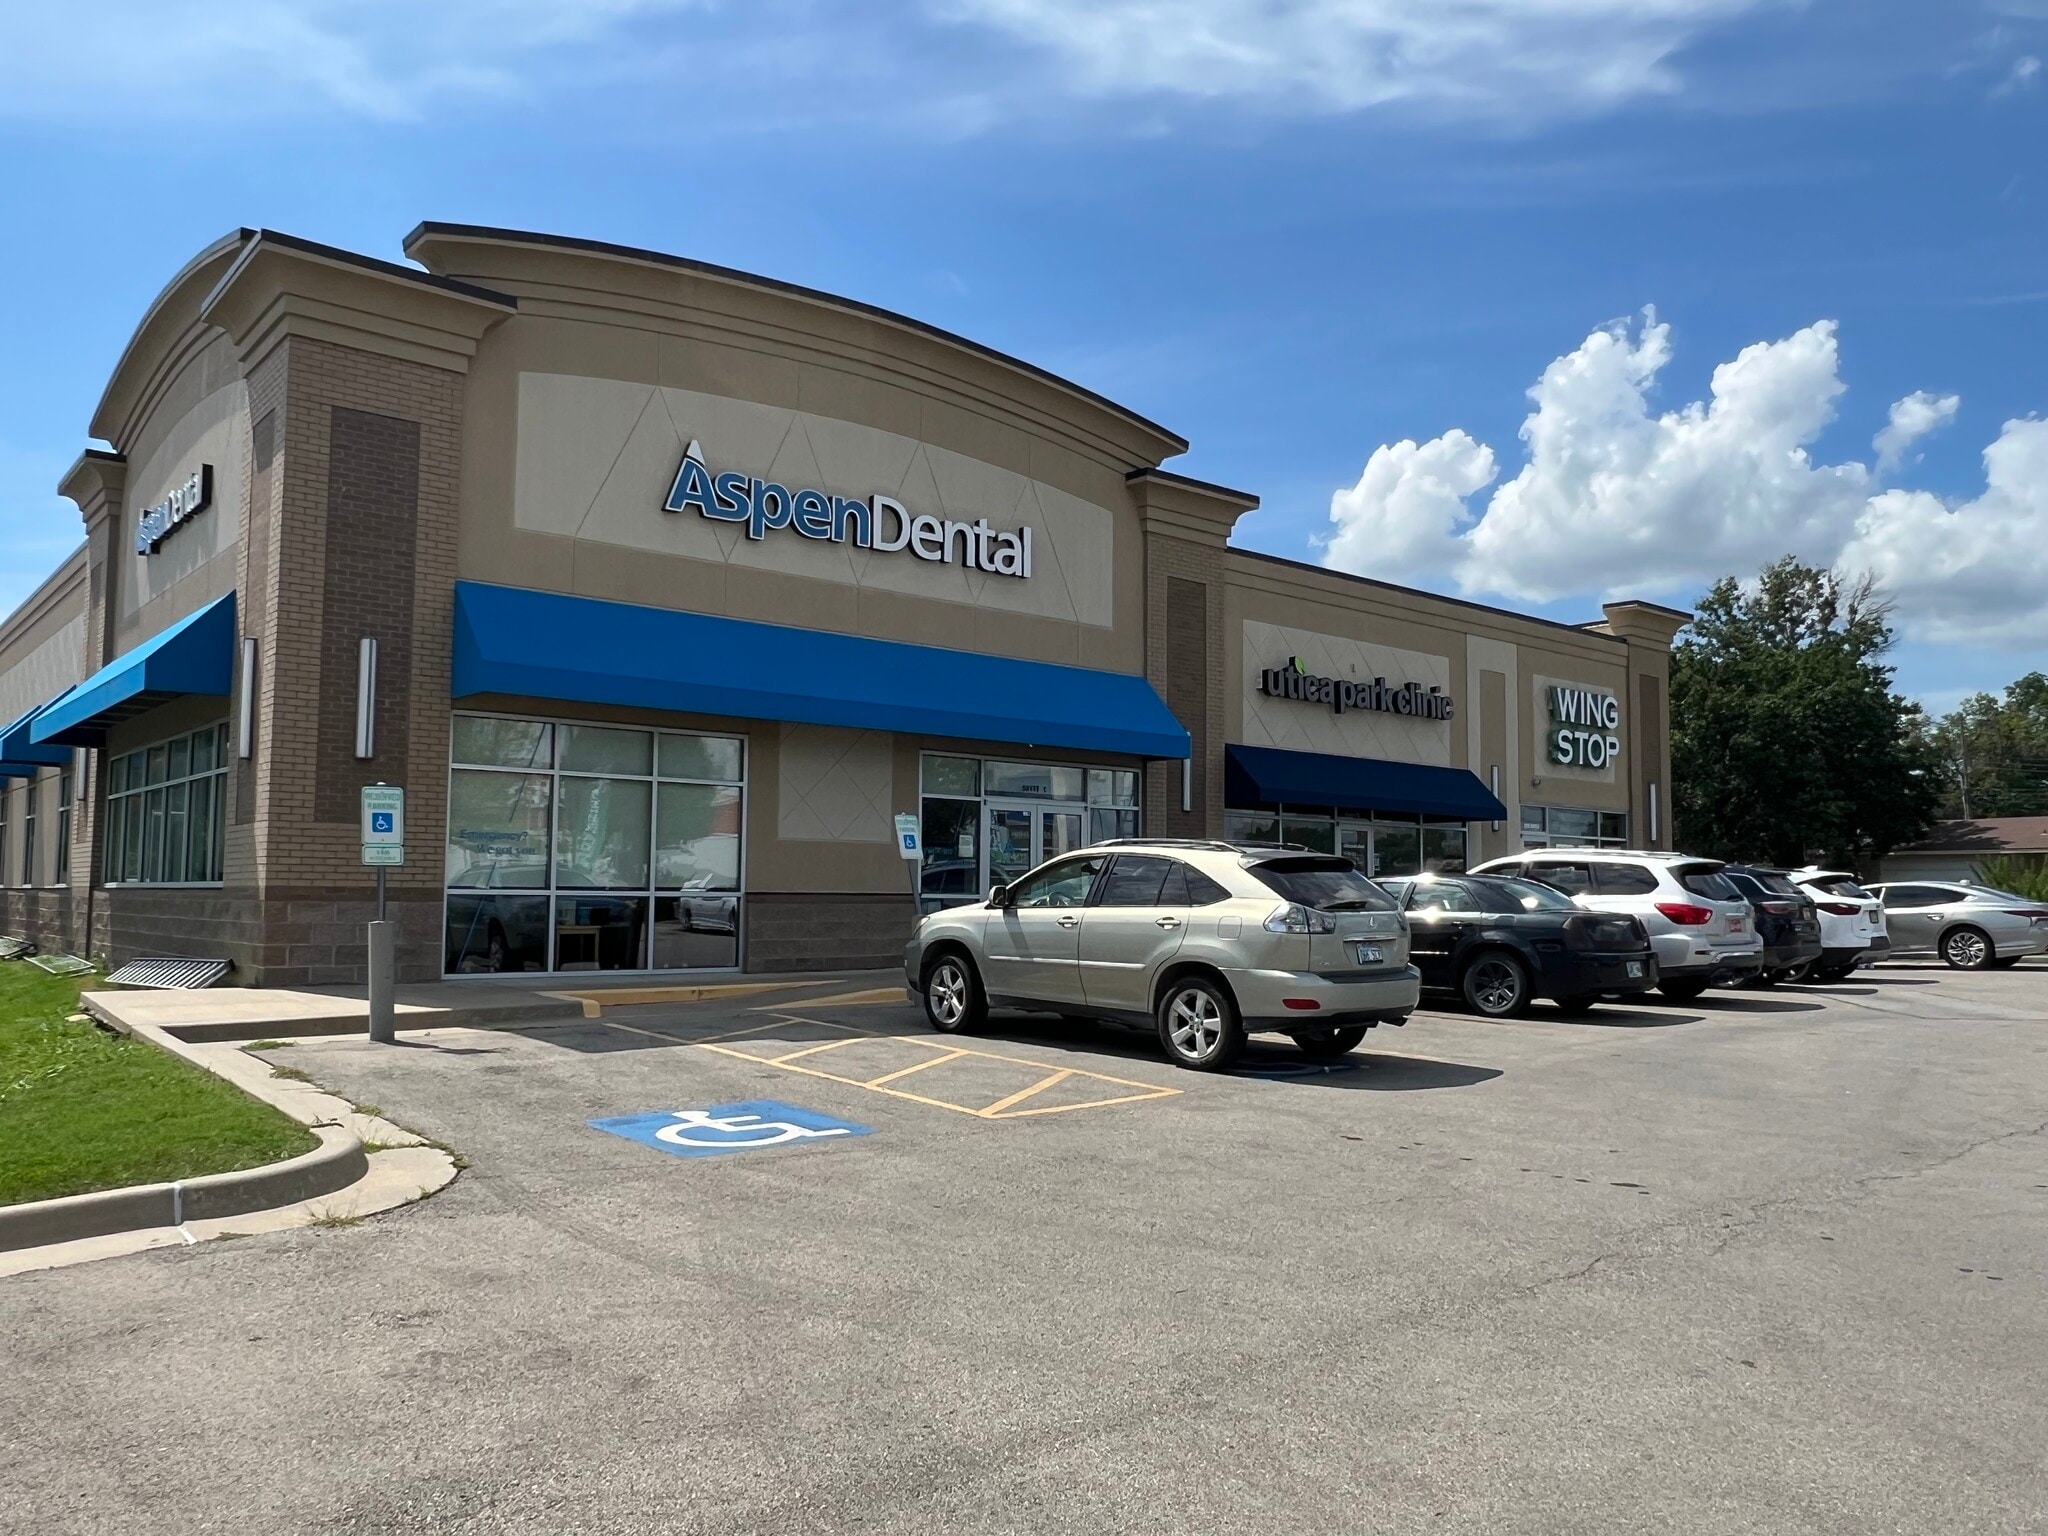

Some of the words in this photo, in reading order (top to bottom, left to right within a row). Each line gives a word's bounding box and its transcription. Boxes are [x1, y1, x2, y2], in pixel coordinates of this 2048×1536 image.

[1263, 656, 1334, 703] utica
[1335, 677, 1395, 714] park
[1394, 682, 1454, 720] clinic
[1556, 687, 1619, 730] WING
[1557, 729, 1620, 768] STOP
